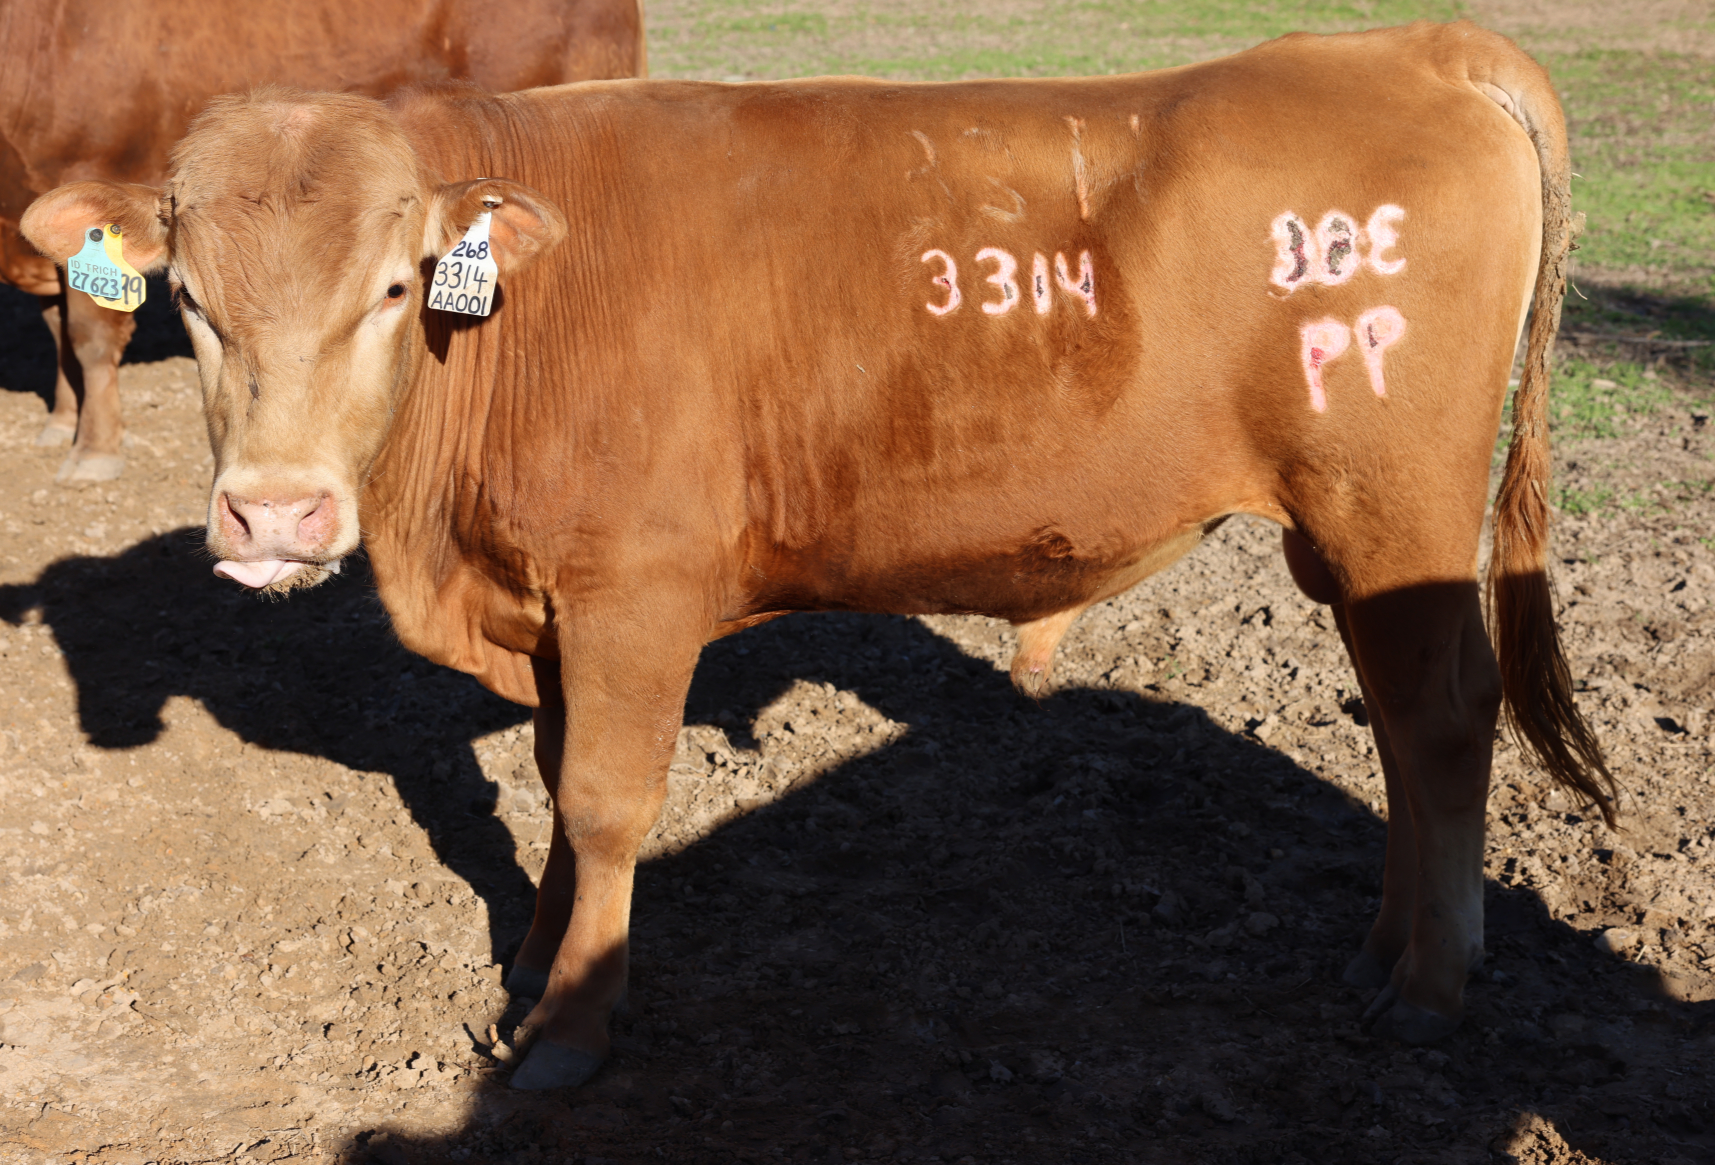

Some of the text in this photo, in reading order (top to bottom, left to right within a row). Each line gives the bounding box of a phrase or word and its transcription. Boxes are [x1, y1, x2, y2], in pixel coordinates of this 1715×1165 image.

[452, 241, 488, 260] 268
[70, 259, 118, 276] ID TRICH
[434, 261, 488, 294] 3314
[921, 246, 1097, 318] 3314
[430, 290, 487, 316] AA001
[1298, 304, 1407, 414] PP
